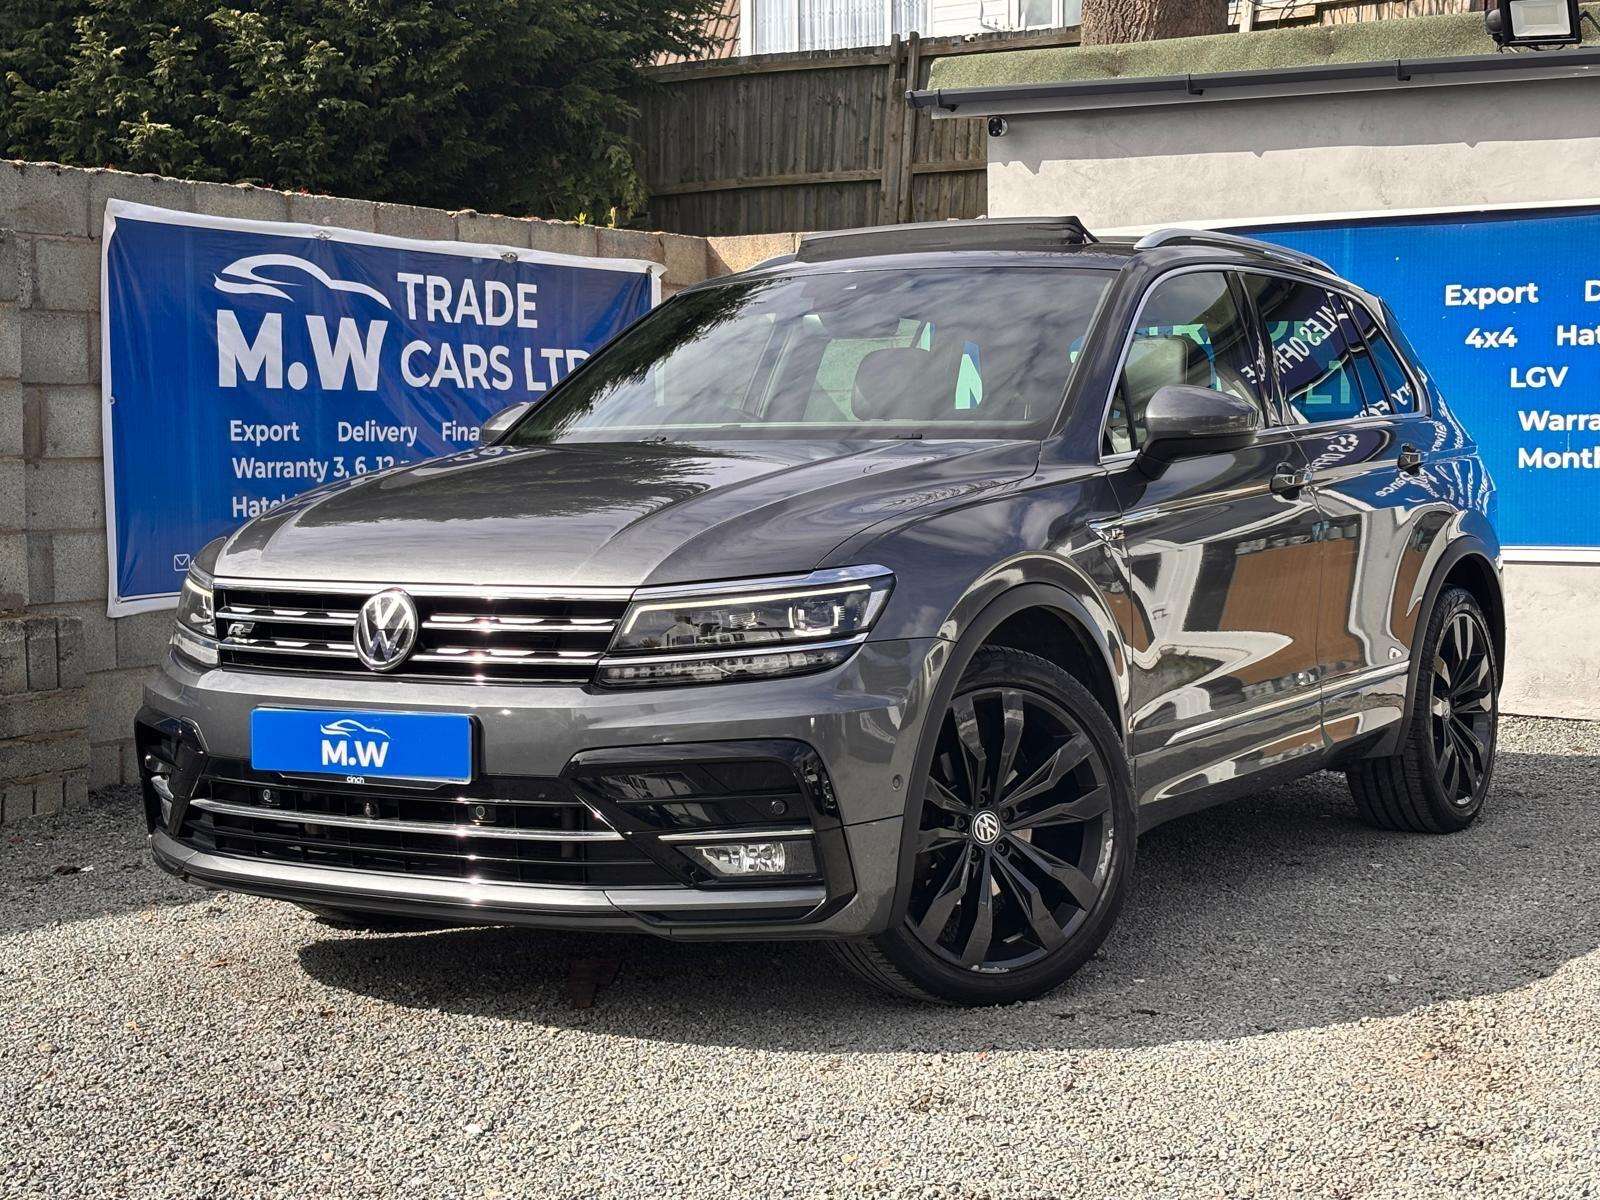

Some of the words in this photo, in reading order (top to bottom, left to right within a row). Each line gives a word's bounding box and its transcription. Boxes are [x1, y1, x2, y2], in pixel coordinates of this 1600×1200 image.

[397, 271, 538, 329] TRADE
[1445, 282, 1539, 310] Export
[217, 310, 388, 391] M.W
[1465, 326, 1518, 349] 4x4
[401, 340, 514, 391] CARS
[1510, 366, 1568, 389] LGV
[230, 419, 300, 447] Export
[337, 420, 418, 447] Delivery
[231, 457, 329, 483] Warranty
[333, 456, 350, 479] 3,
[321, 739, 389, 768] M.W
[346, 775, 365, 785] cinch
